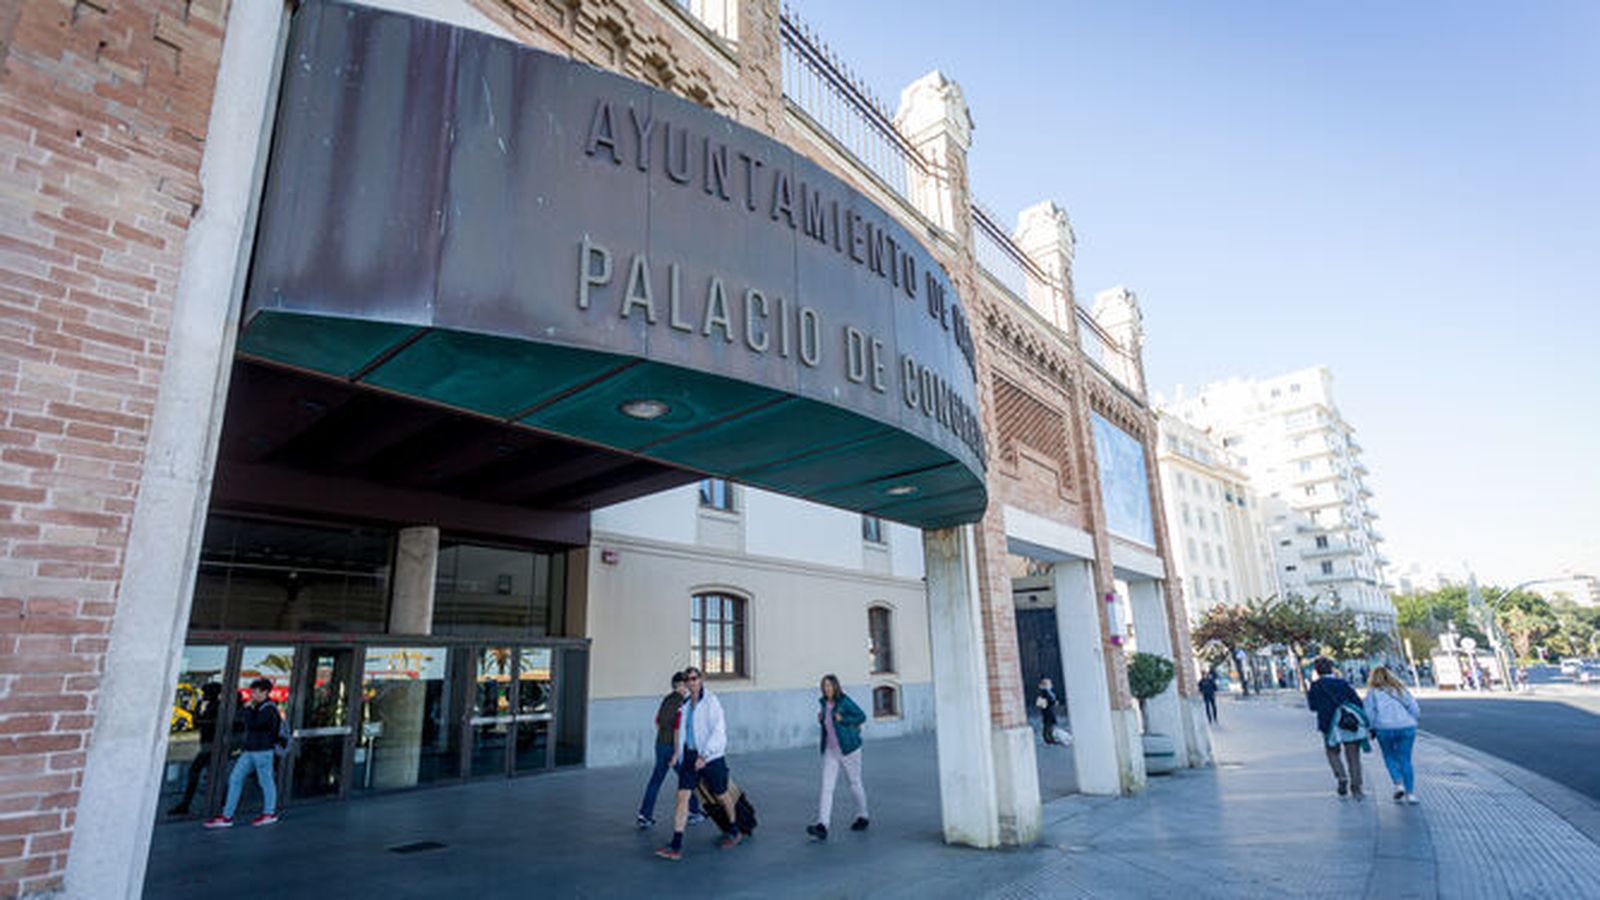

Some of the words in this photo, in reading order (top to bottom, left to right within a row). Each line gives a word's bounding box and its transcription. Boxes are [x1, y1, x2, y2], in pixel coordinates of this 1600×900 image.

[585, 99, 917, 299] AYUNTAMIENTO
[926, 271, 949, 331] DE
[578, 237, 821, 367] PALACIO
[845, 325, 887, 394] DE
